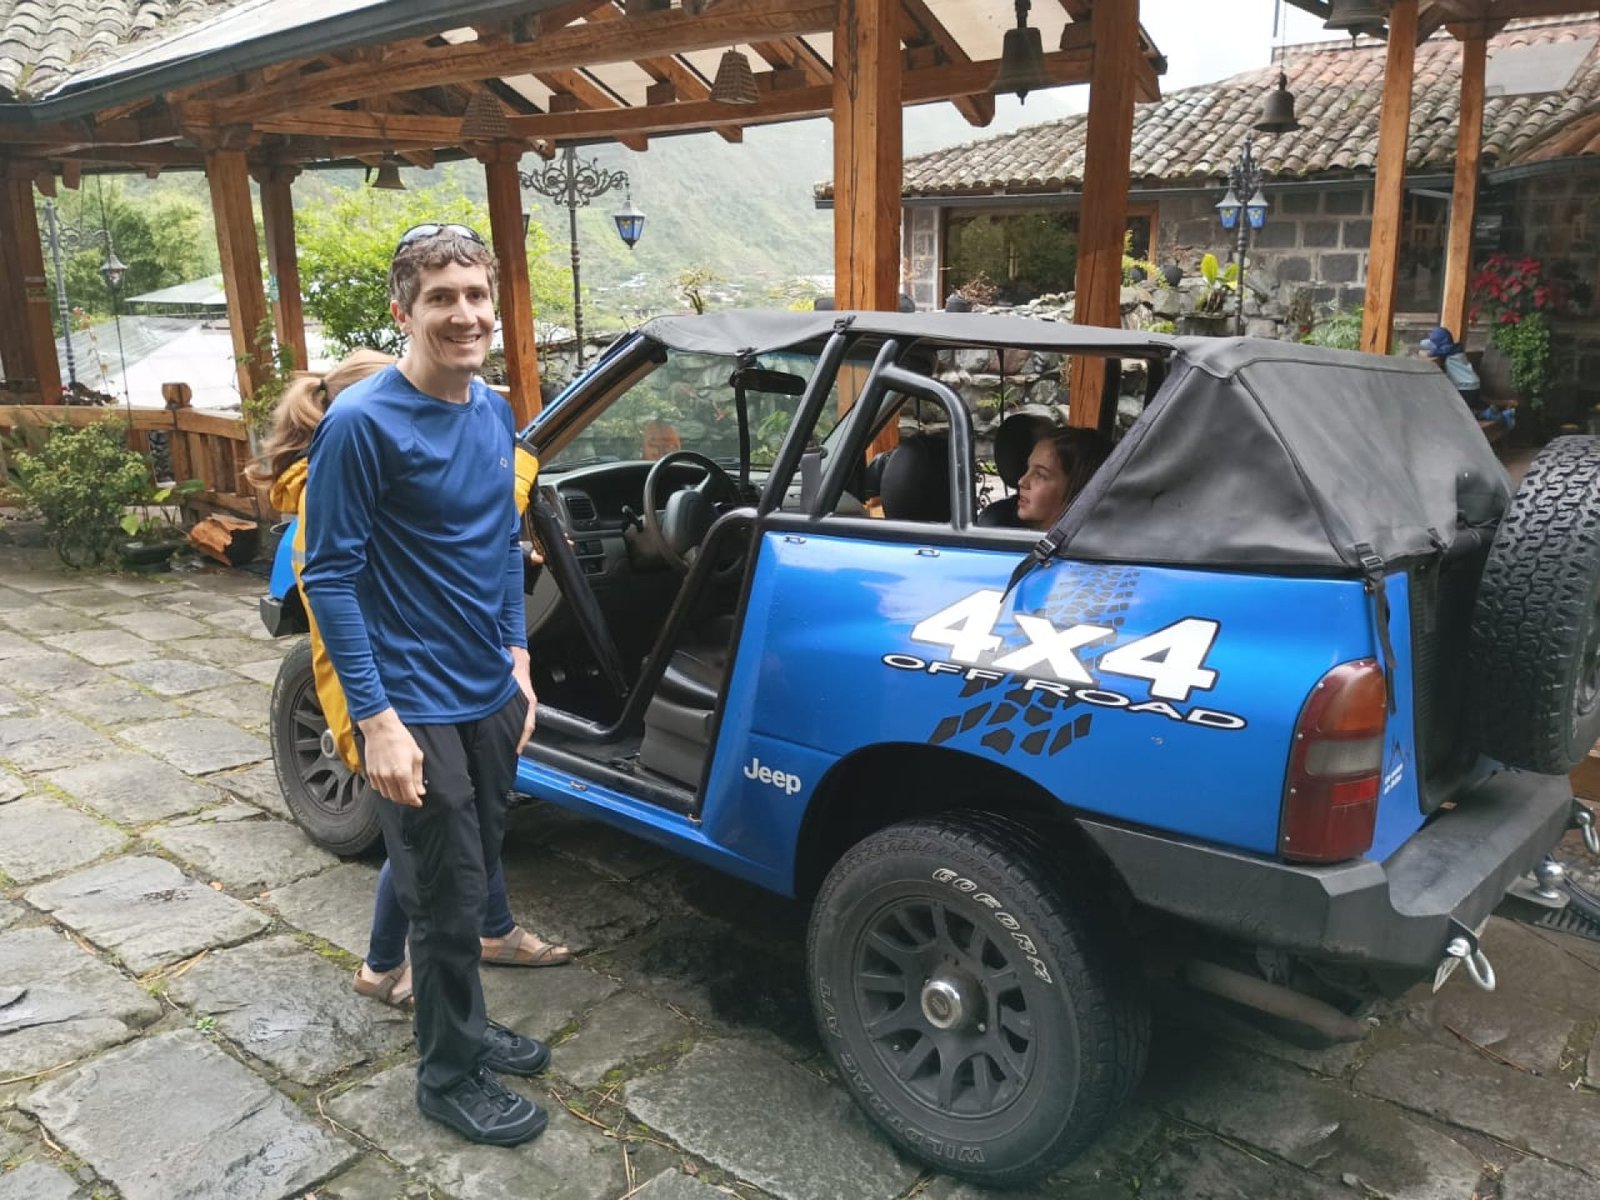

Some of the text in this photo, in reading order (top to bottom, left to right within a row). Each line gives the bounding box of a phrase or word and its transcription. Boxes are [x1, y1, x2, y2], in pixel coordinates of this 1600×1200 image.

[880, 653, 1248, 730] OFF ROAD
[743, 757, 802, 795] Jeep
